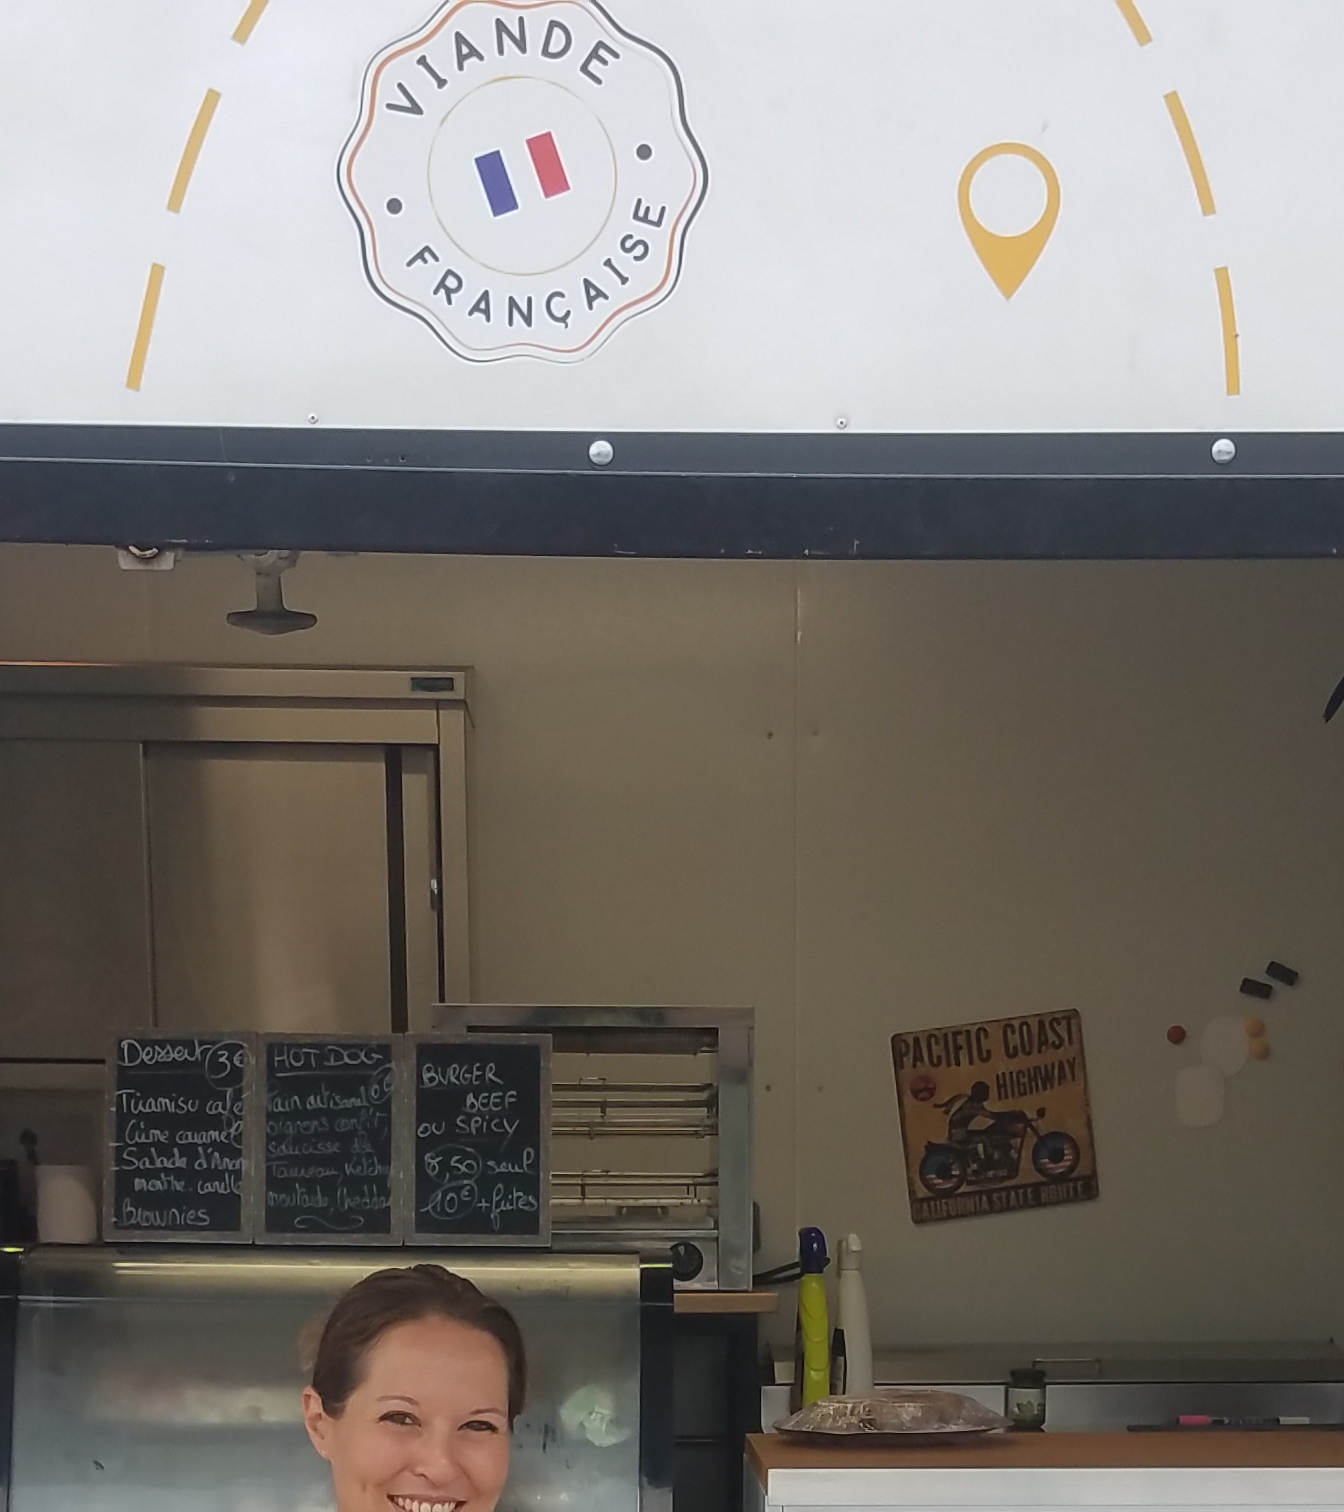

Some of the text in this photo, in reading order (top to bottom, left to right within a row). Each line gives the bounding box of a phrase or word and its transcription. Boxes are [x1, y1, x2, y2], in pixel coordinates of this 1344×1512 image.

[385, 16, 620, 116] VIANDE
[406, 198, 666, 328] FRANÇAISE
[275, 1046, 383, 1067] HOT DOG
[898, 1016, 1076, 1070] PACIFIC COAST
[420, 1063, 504, 1088] BURGER
[995, 1057, 1077, 1101] HIGHWAY
[463, 1091, 517, 1112] BEEF
[119, 1197, 210, 1227] Brownies
[913, 1182, 1084, 1221] CALIFORNIA STATE ROUTE
